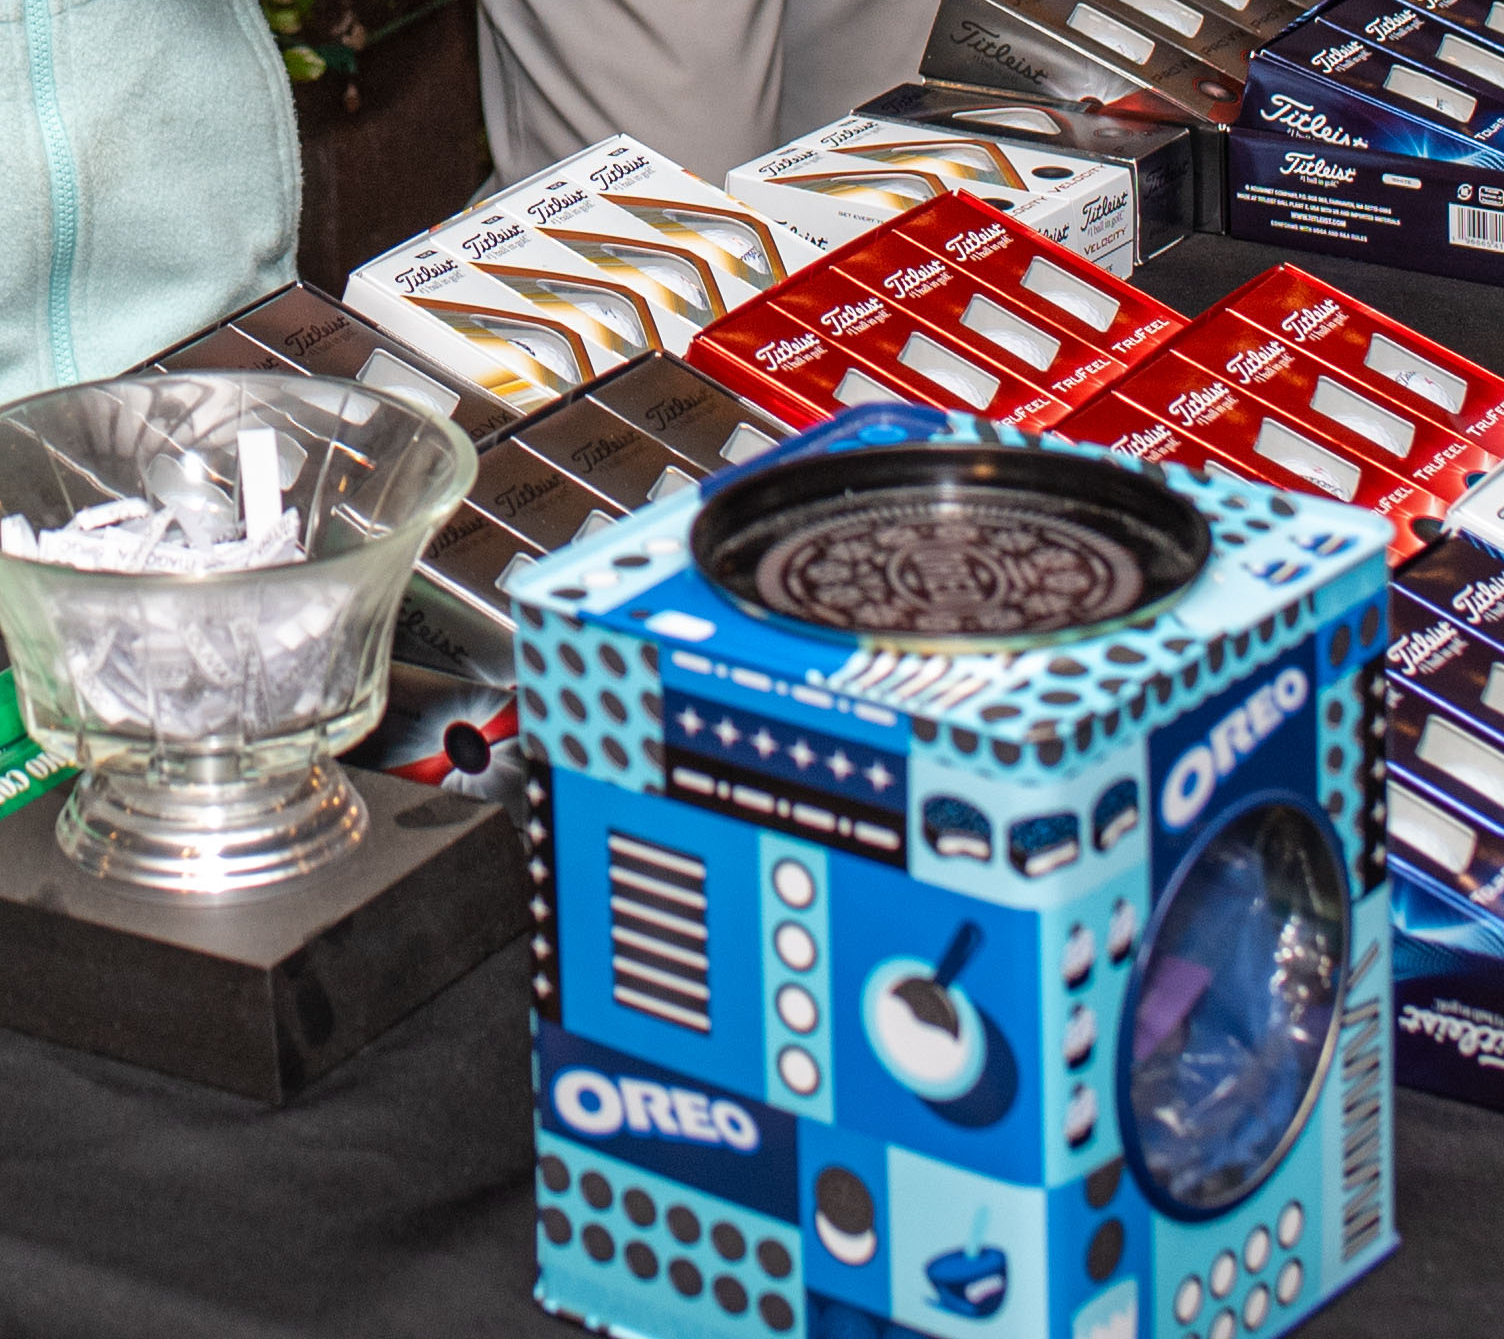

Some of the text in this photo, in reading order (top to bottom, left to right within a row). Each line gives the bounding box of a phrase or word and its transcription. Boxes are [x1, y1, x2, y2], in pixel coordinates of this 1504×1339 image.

[1365, 9, 1417, 43] Titleist
[1311, 41, 1364, 73] Titleist
[820, 120, 879, 147] Titleist
[1260, 93, 1369, 148] Titleist
[590, 155, 649, 190] Titleist
[759, 149, 819, 177] Titleist
[1279, 152, 1356, 182] Titleist
[528, 189, 588, 224] Titleist
[1080, 191, 1128, 232] Titleist
[462, 224, 524, 259] Titleist
[945, 223, 1006, 262] Titleist
[1084, 228, 1126, 255] VELOCITY
[395, 258, 458, 294] Titleist
[884, 259, 946, 300] Titleist
[821, 297, 884, 336] Titleist
[1111, 317, 1170, 354] TRUFEEL
[1281, 298, 1340, 342] Titleist
[755, 332, 820, 371] Titleist
[1226, 339, 1286, 384] Titleist
[1052, 358, 1111, 393] TRUFEEL
[1168, 382, 1230, 427] Titleist
[1413, 441, 1468, 482] TRUFEEL
[1385, 621, 1458, 675] Titleist
[1158, 664, 1311, 835] OREO
[551, 1067, 761, 1157] OREO
